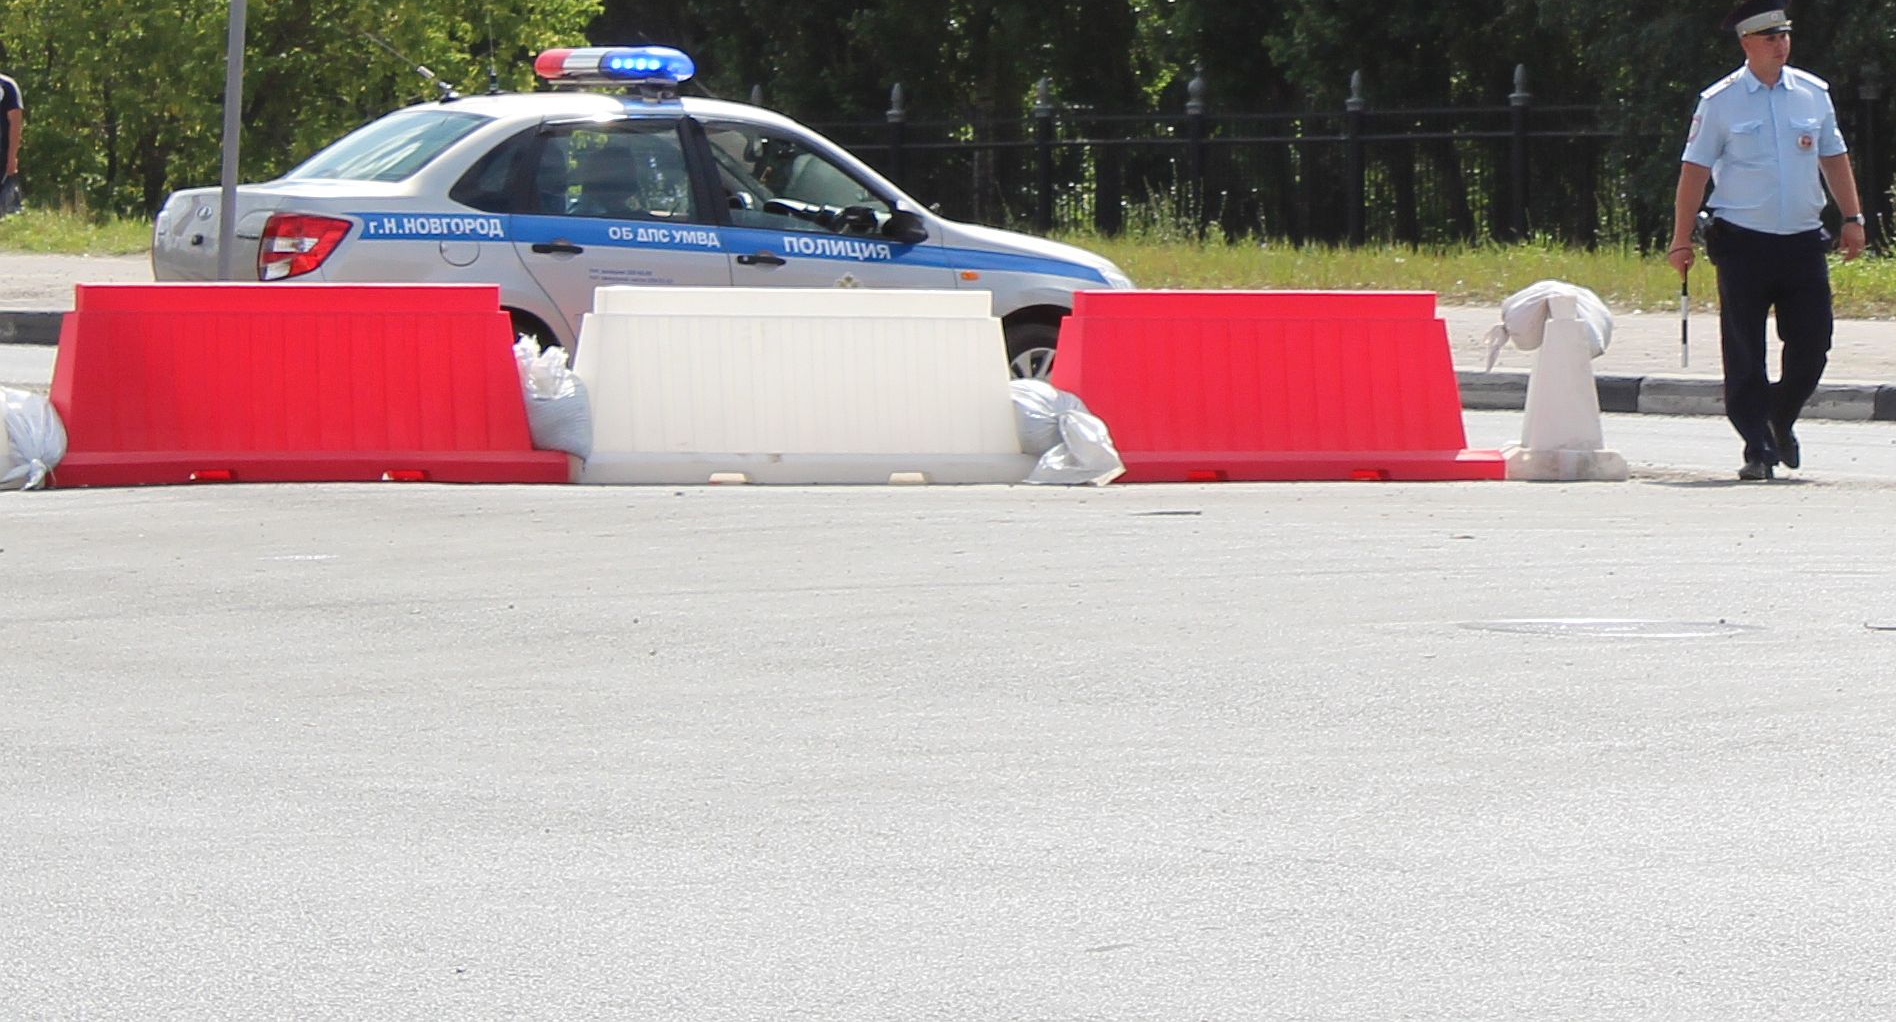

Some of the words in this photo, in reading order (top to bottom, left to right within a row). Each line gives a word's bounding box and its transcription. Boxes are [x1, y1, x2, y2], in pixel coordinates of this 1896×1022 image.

[608, 226, 633, 240] ОБ
[637, 228, 670, 243] ДПС
[671, 229, 721, 249] УМВД
[783, 236, 892, 261] ПОЛИЦИЯ
